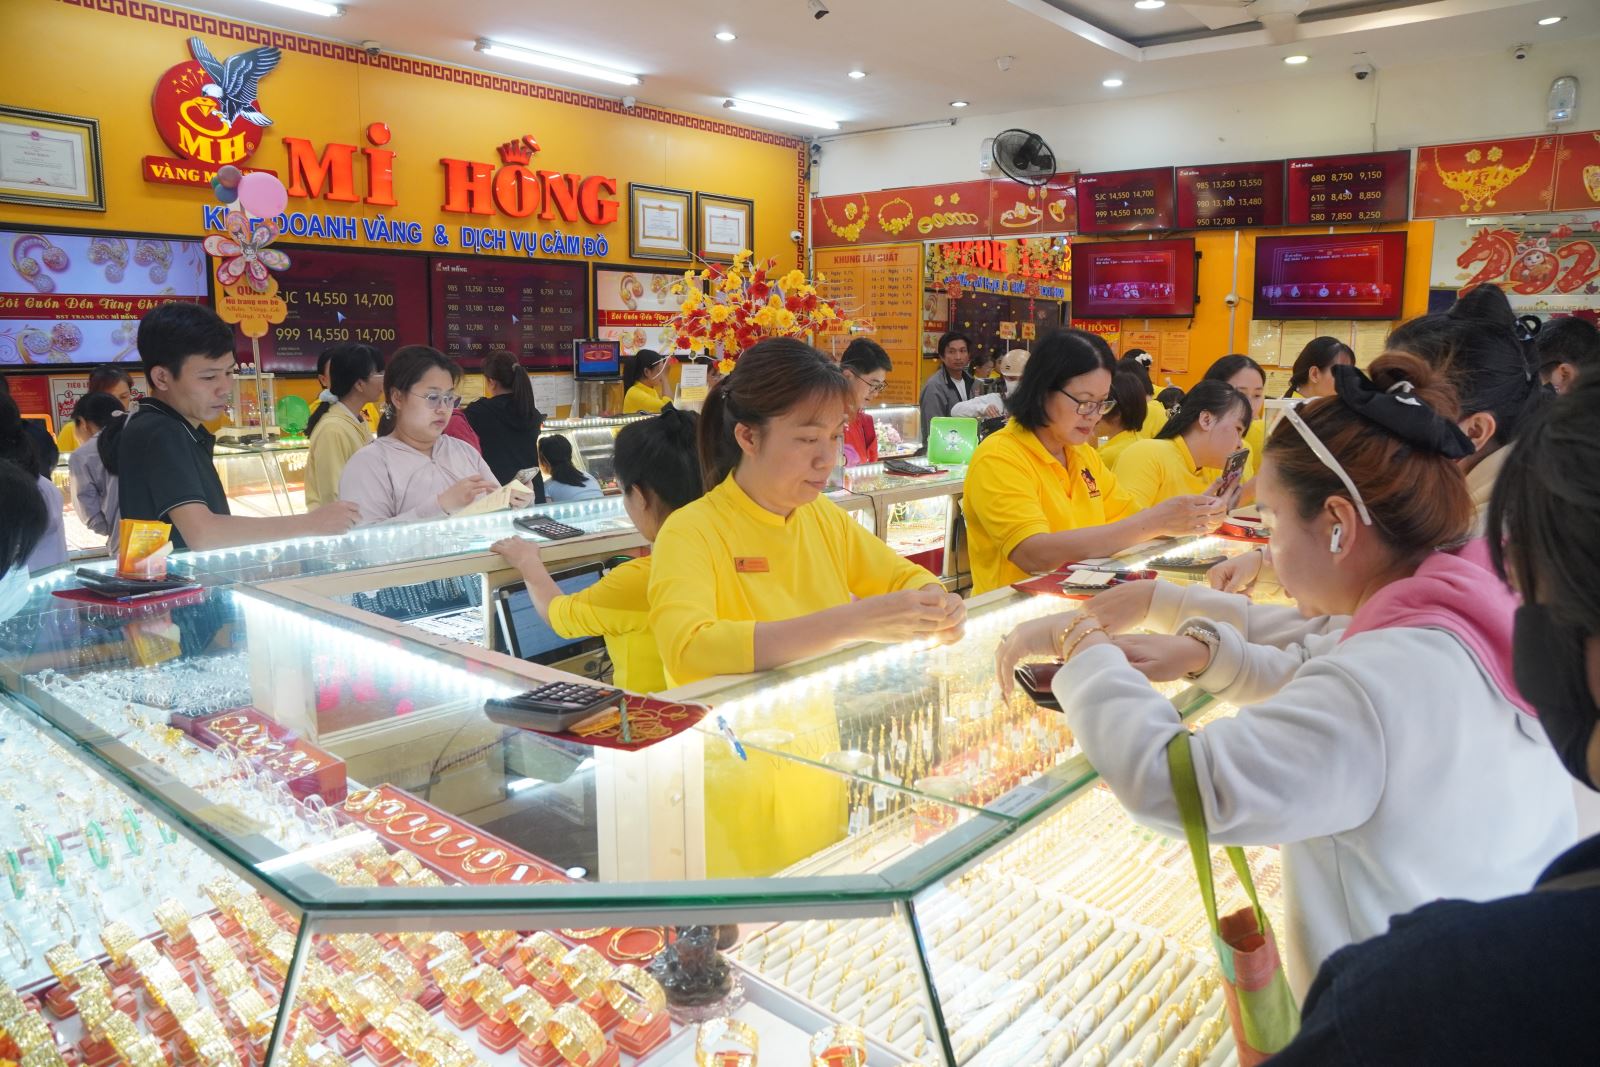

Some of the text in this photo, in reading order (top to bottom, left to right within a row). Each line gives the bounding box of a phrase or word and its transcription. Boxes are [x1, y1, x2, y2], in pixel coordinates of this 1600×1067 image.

[177, 121, 246, 164] MH
[150, 162, 200, 181] VÀNG
[1311, 171, 1382, 182] 680 8,750 9,150
[439, 134, 619, 225] HỒNG
[1196, 179, 1262, 190] 985 13,250 13,550
[1108, 192, 1130, 200] 14,550
[1133, 190, 1154, 198] 14,700
[1311, 191, 1381, 202] 610 8,450 8,850
[1196, 198, 1262, 208] 980 13,180 13,480
[1110, 210, 1130, 218] 14,550
[1134, 208, 1155, 216] 14,700
[1331, 212, 1352, 220] 7,850
[1359, 211, 1381, 219] 8,250
[1213, 218, 1235, 226] 12,780
[272, 212, 356, 240] DOANH
[362, 213, 422, 244] VÀNG
[434, 224, 449, 245] &
[462, 226, 506, 254] DỊCH
[510, 231, 537, 257] VỤ
[540, 230, 580, 256] CẦM
[583, 233, 608, 257] ĐỒ
[834, 256, 860, 264] KHUNG
[305, 291, 347, 306] 14,550
[354, 293, 394, 307] 14,700
[1087, 320, 1116, 332] HỒNG
[276, 328, 395, 343] 999 14,550 14,700
